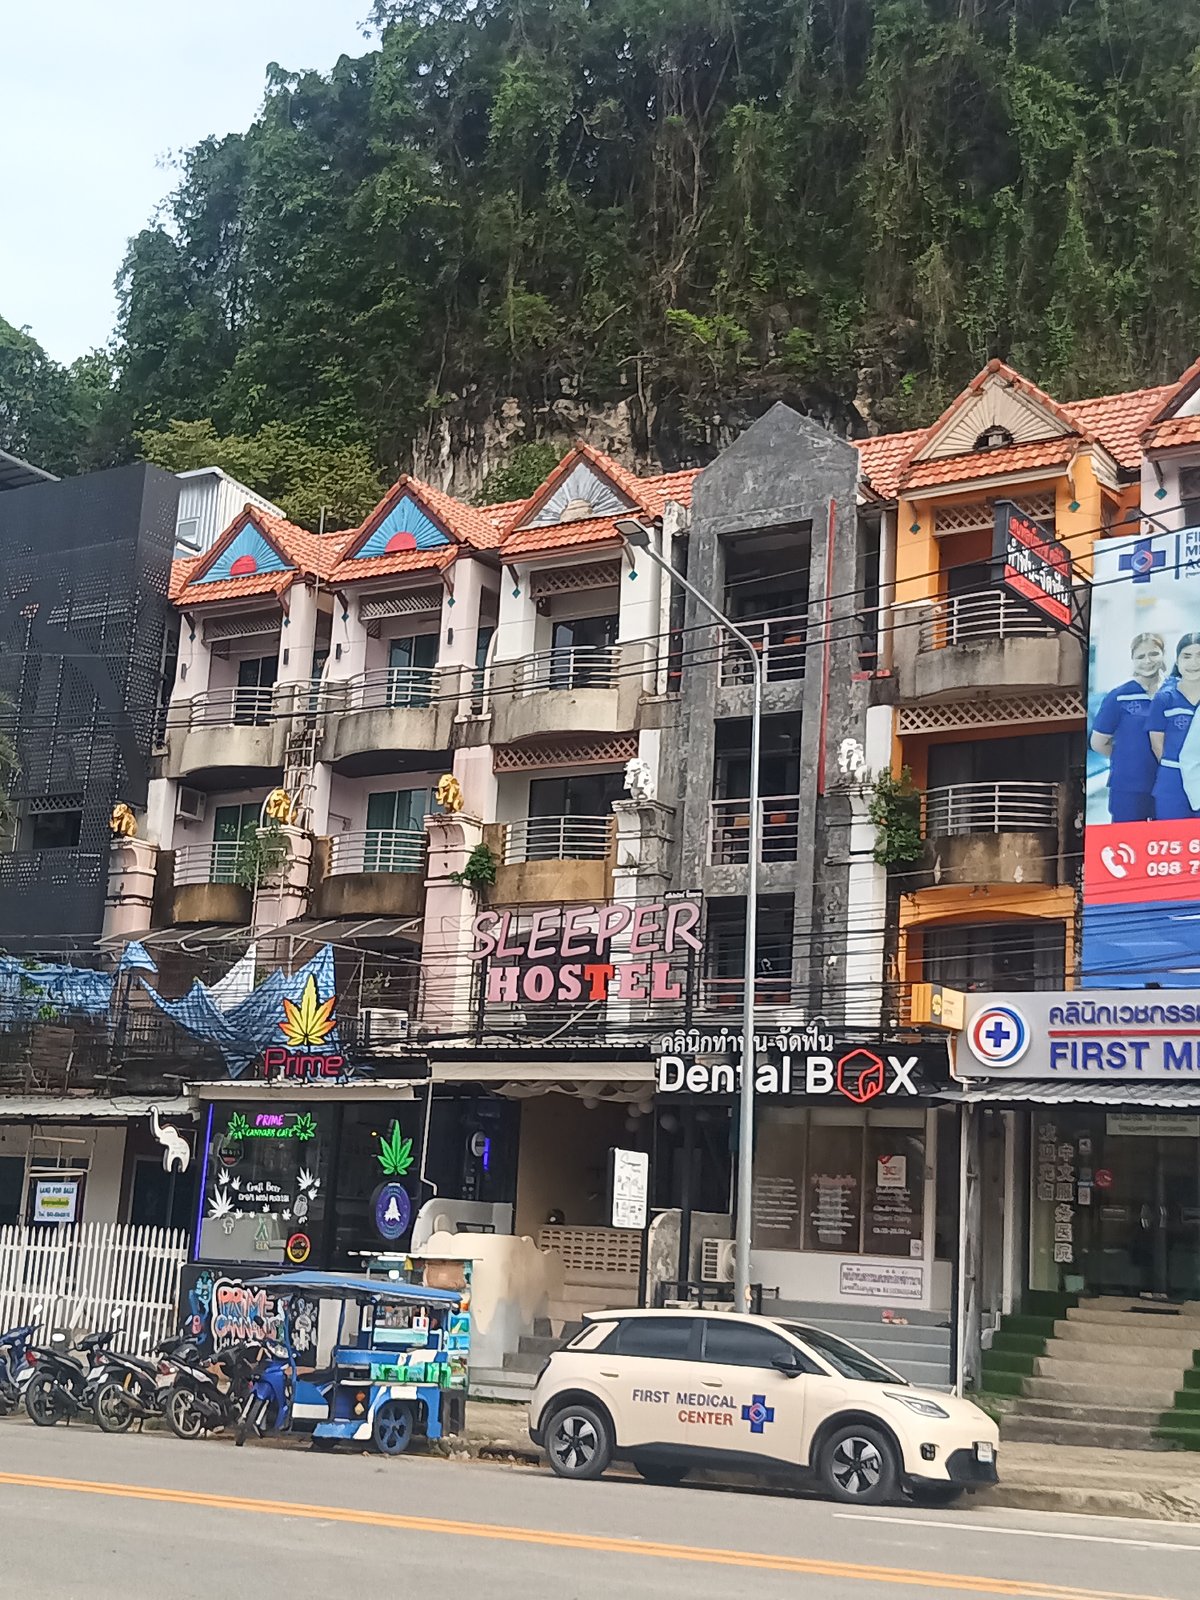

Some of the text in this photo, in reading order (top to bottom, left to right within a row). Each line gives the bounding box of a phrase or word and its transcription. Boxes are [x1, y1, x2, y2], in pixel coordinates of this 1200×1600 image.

[1185, 530, 1200, 546] FI
[1185, 544, 1200, 557] M
[1147, 840, 1182, 856] 075
[1146, 861, 1182, 877] 098
[467, 901, 703, 961] SLEEPER
[487, 961, 682, 1003] HOSTEL
[1049, 1001, 1200, 1025] คลินิกเวชกรร
[263, 1048, 344, 1077] Prime
[1050, 1041, 1200, 1071] FIRST M
[659, 1056, 791, 1094] Denal
[255, 1114, 284, 1127] PRIME
[632, 1389, 737, 1409] FIRST MEDICAL
[678, 1410, 734, 1426] CENTER
